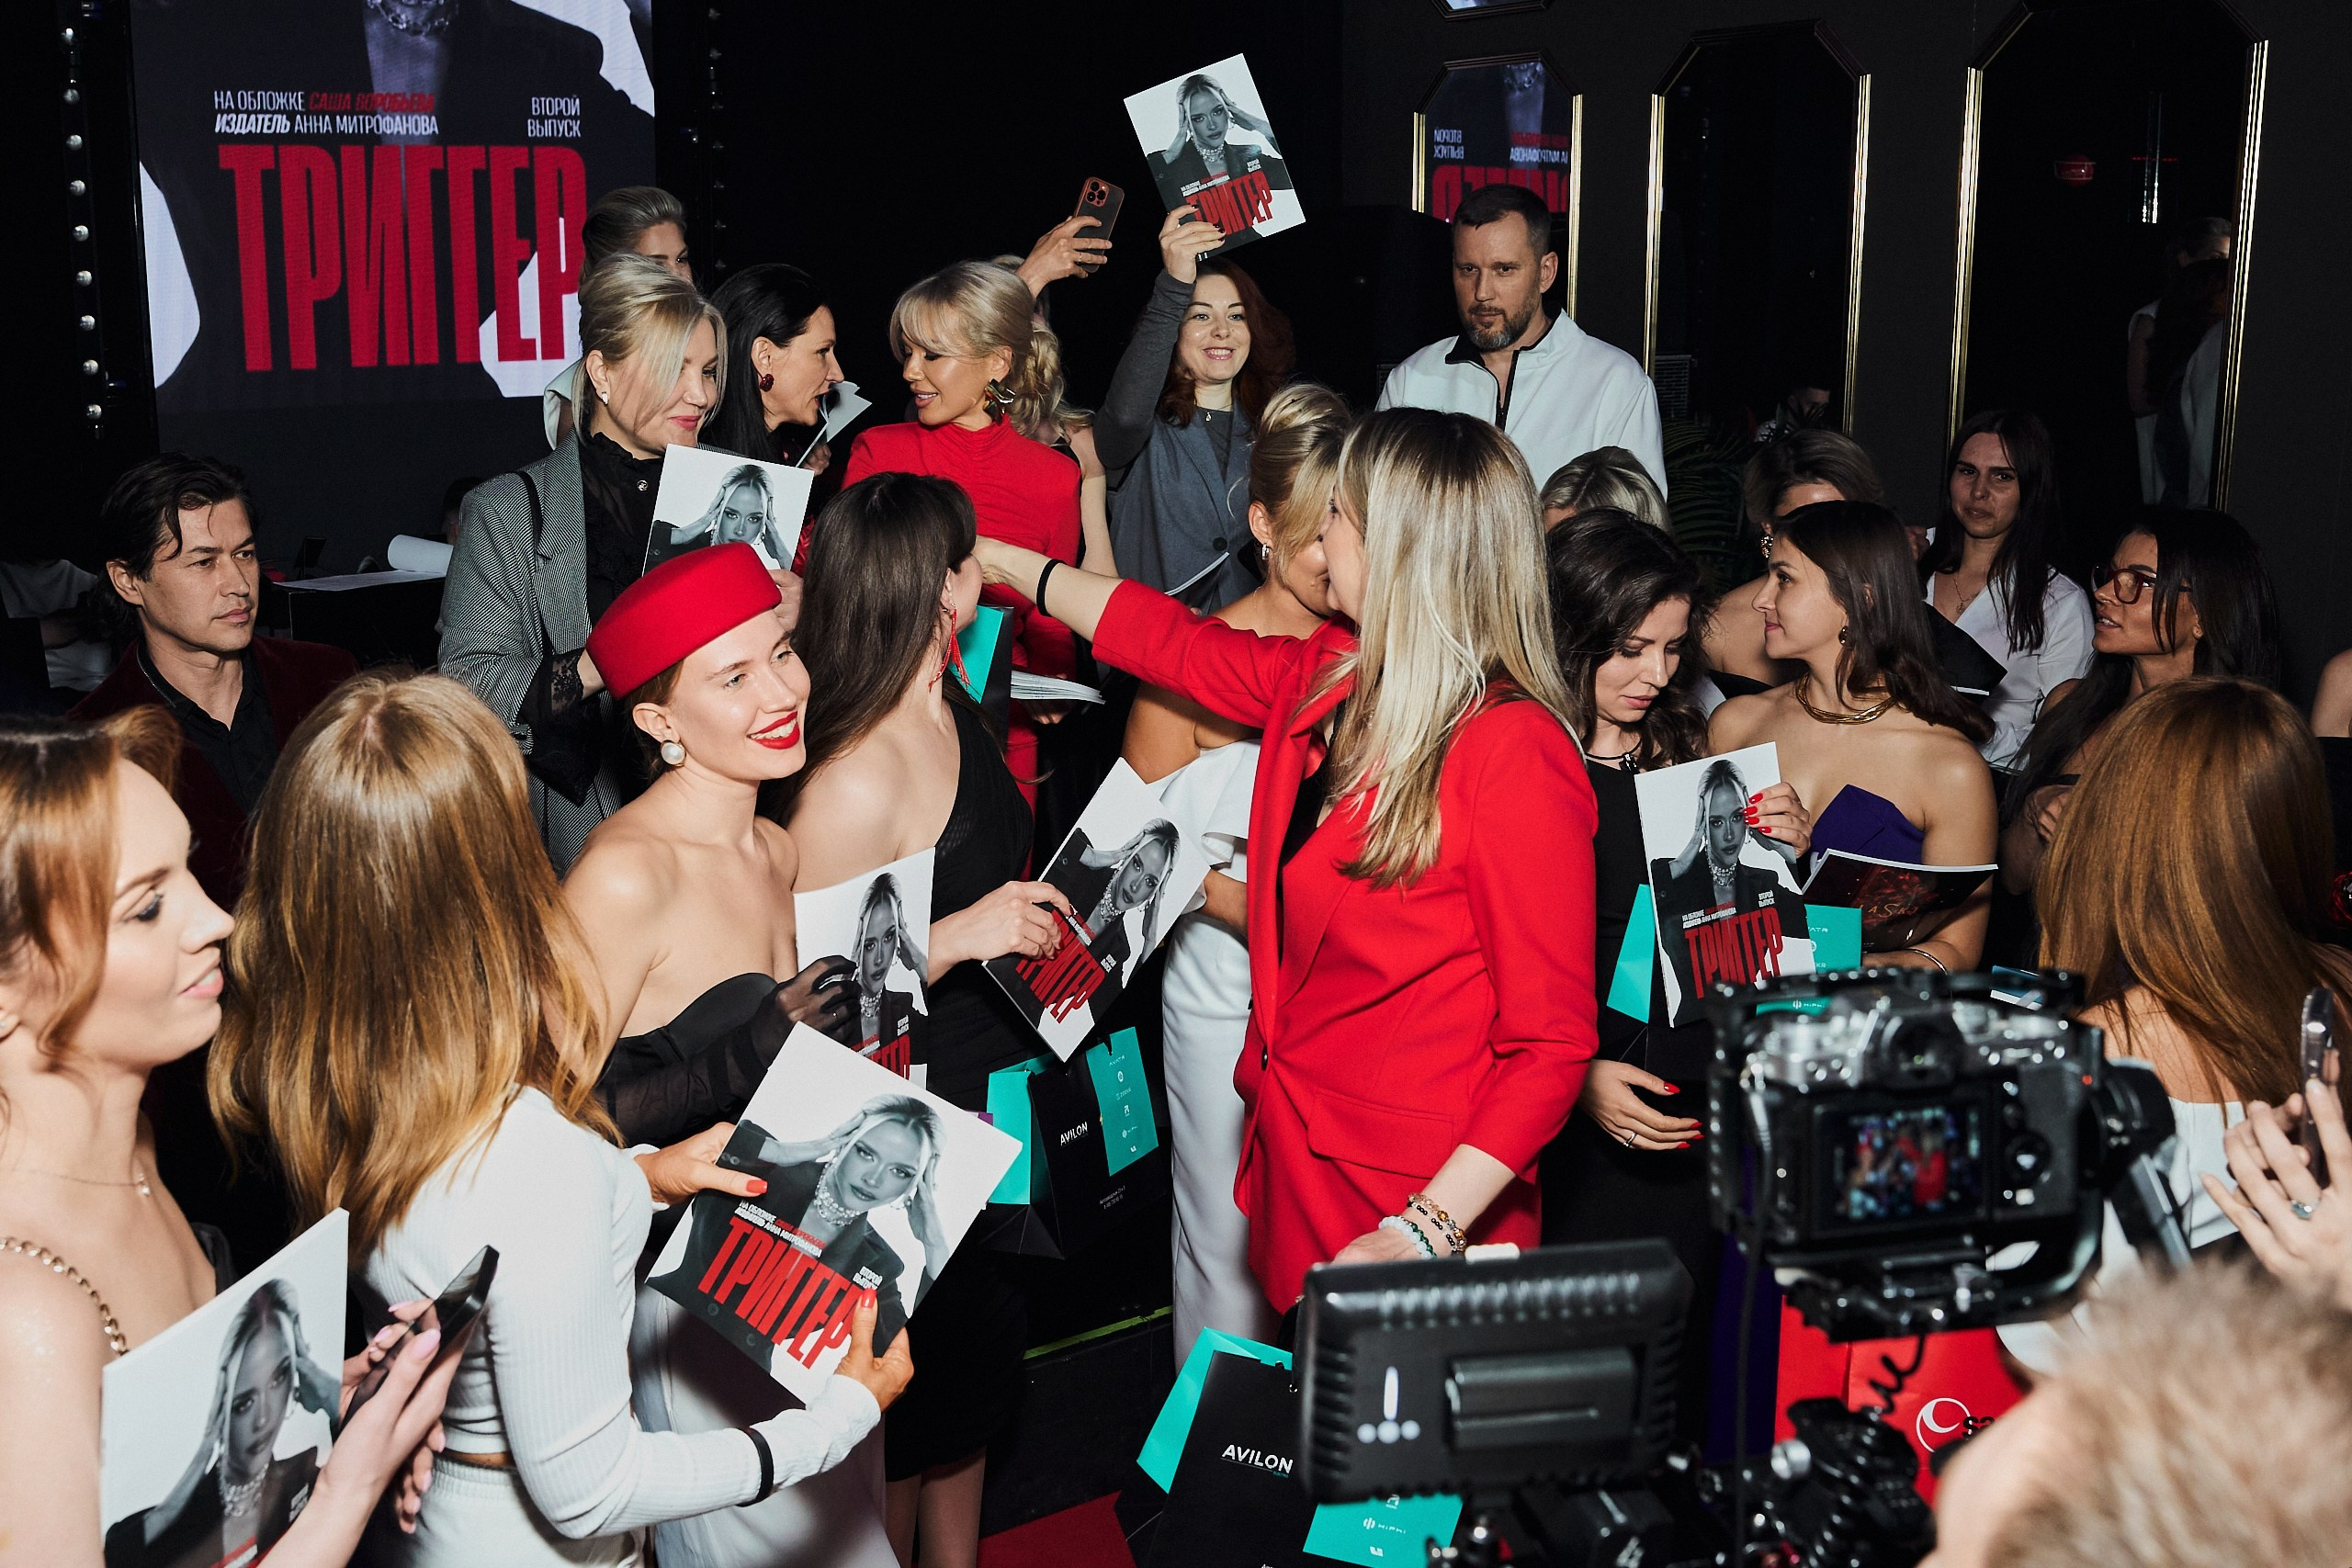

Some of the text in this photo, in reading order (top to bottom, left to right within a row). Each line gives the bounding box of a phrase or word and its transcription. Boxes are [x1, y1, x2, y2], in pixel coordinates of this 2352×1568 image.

[214, 90, 234, 110] НА
[237, 90, 305, 111] ОБЛОЖКЕ
[309, 92, 352, 111] САША
[531, 95, 581, 116] ВТОРОЙ
[214, 113, 439, 135] ИЗДАТЕЛЬ АННА МИТРОФАНОВА
[527, 118, 582, 138] ВЫПУСК
[218, 143, 588, 372] ТРИГГЕР
[1684, 907, 1784, 999] ТРИГГЕР
[1060, 1121, 1088, 1146] AVILON
[697, 1216, 865, 1370] ТРИГГЕР
[1221, 1444, 1294, 1474] AVILON
